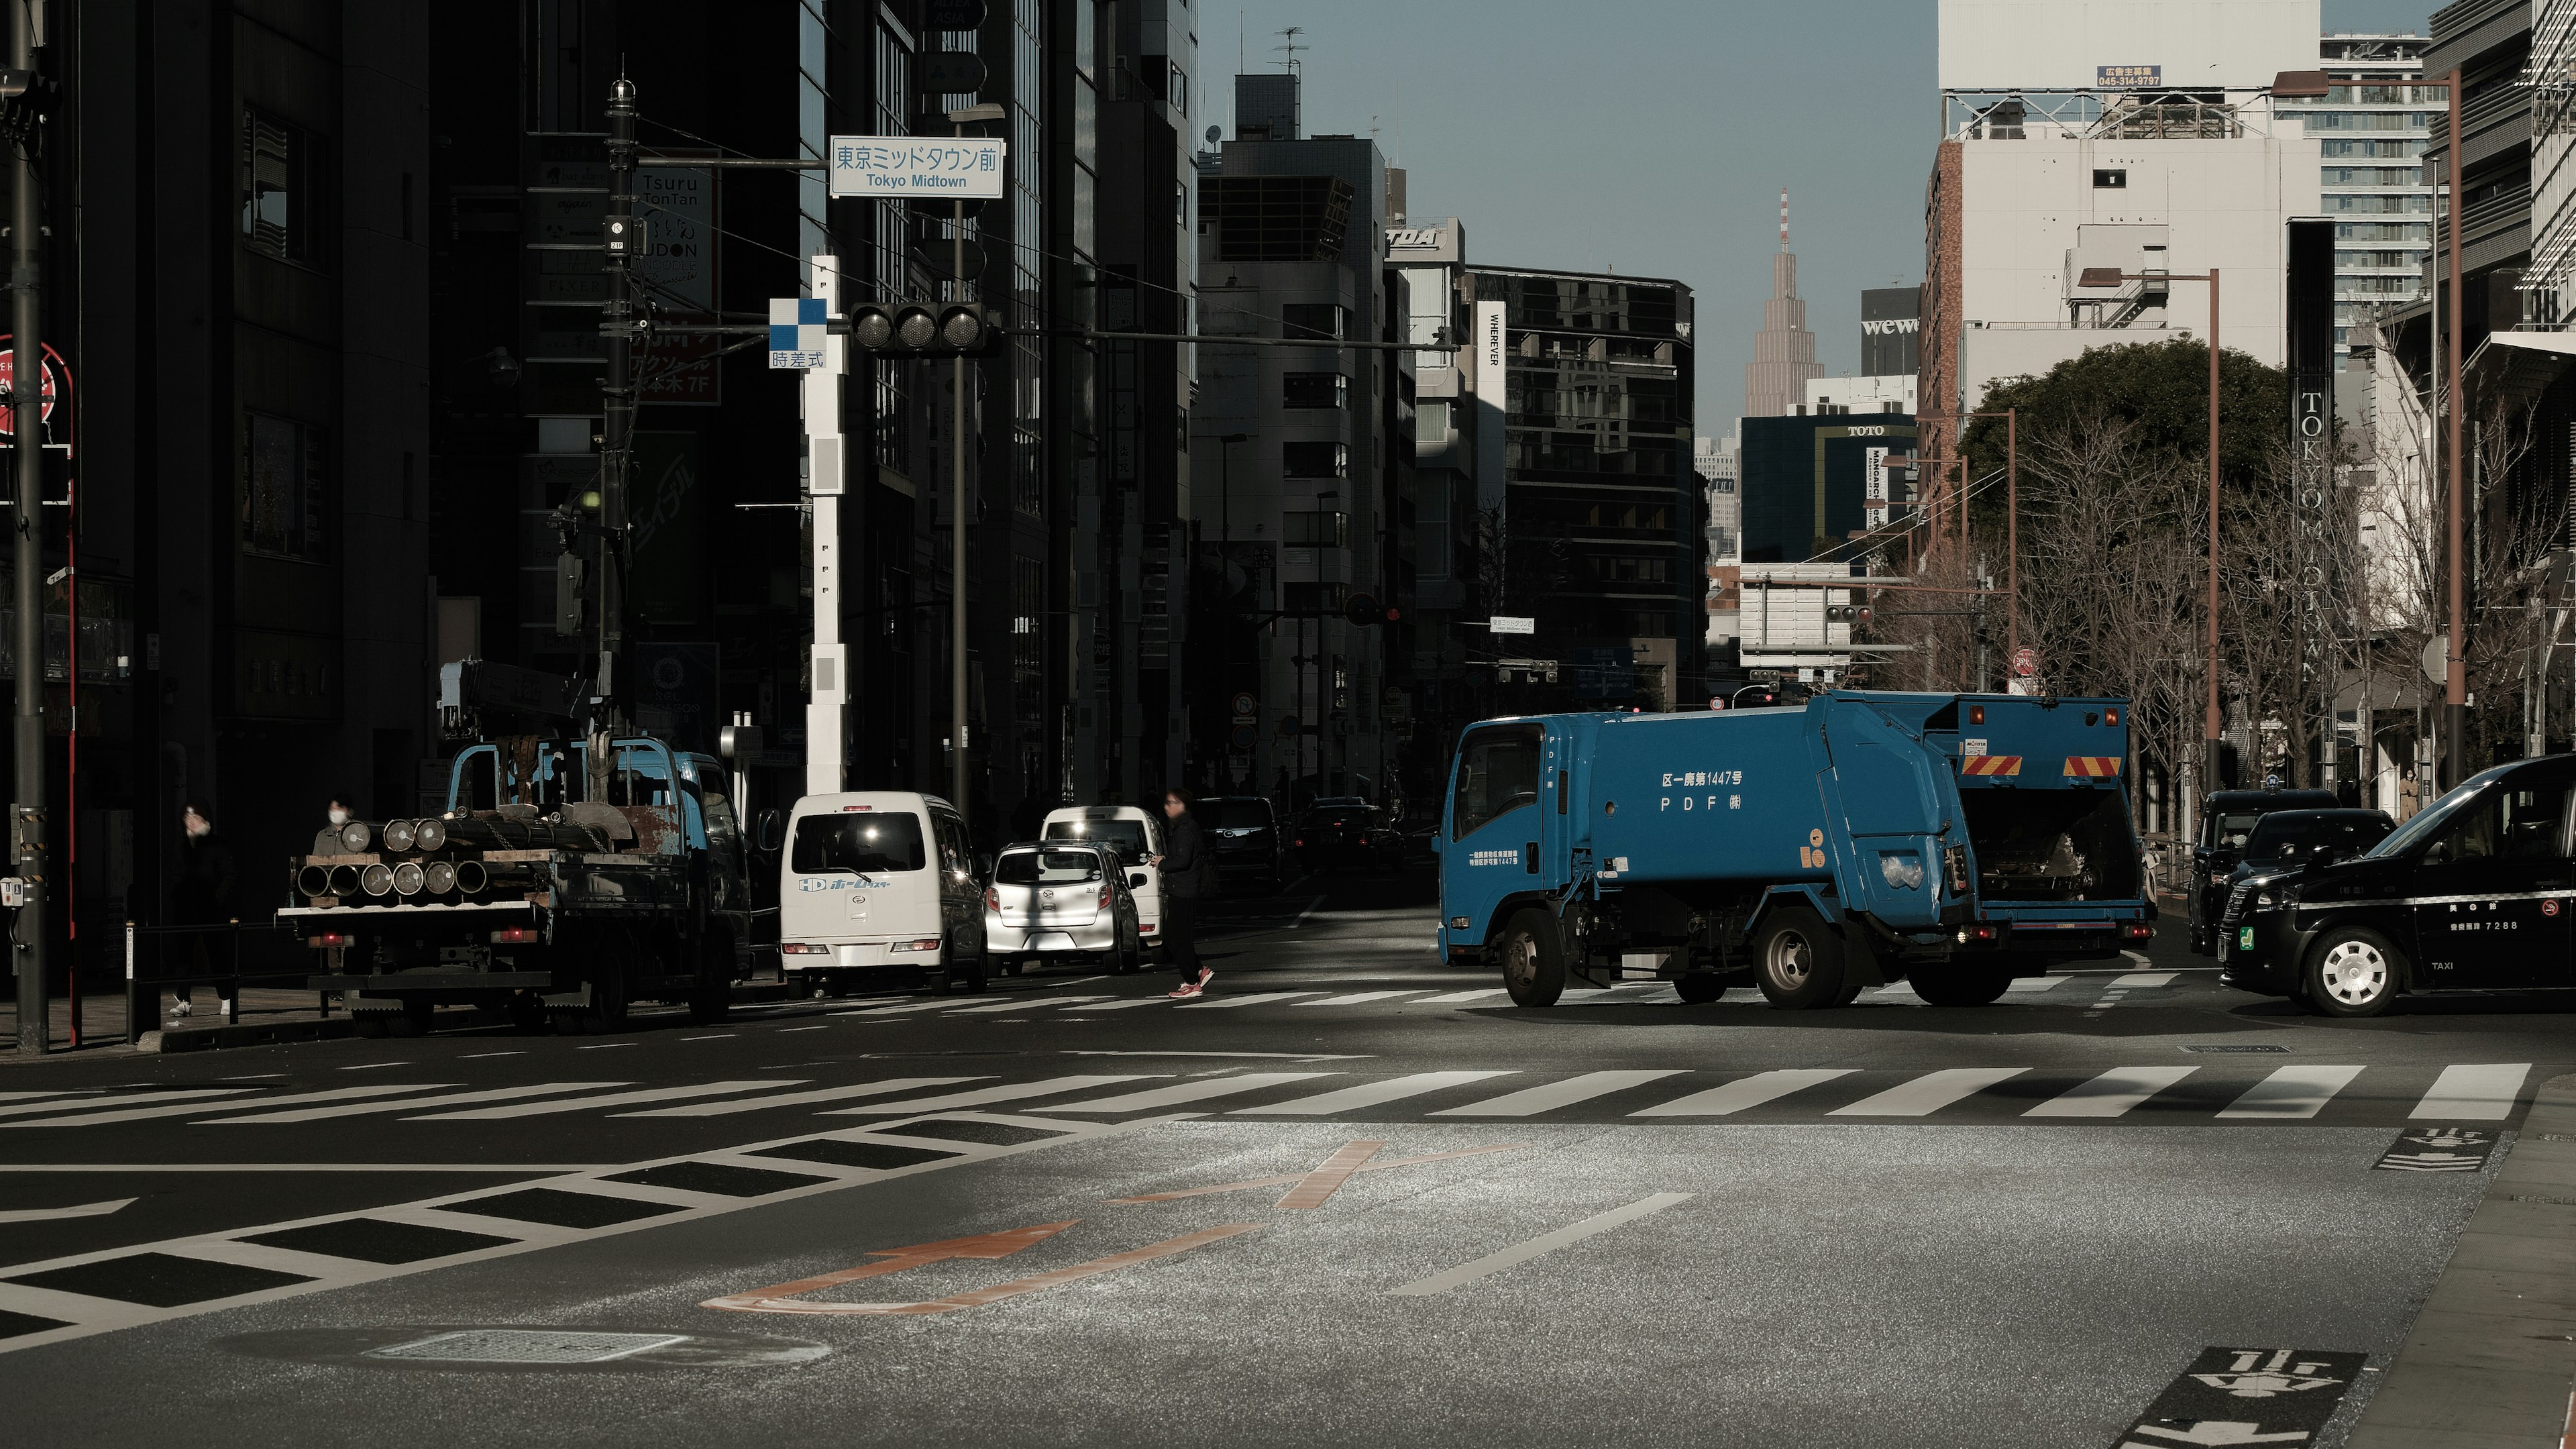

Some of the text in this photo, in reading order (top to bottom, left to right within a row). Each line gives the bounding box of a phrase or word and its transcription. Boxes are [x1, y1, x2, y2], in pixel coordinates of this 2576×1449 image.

[934, 11, 966, 24] ASIA
[2098, 76, 2159, 86] 045-314-9797
[837, 146, 997, 171] 東京ミッドタウン前
[643, 175, 697, 191] Tsuru
[866, 174, 967, 189] Tokyo Midtown
[557, 197, 592, 213] again
[643, 193, 697, 205] TonTan
[1490, 314, 1499, 366] WHEREVER
[773, 352, 823, 368] 時差式
[688, 376, 709, 392] 7F
[1847, 426, 1884, 437] TOTO
[2301, 392, 2323, 508] TOKYO
[1662, 771, 1742, 787] 区一廃第1447号
[799, 877, 826, 892] HD
[2486, 922, 2517, 930] 7288
[2431, 962, 2453, 970] TAXI
